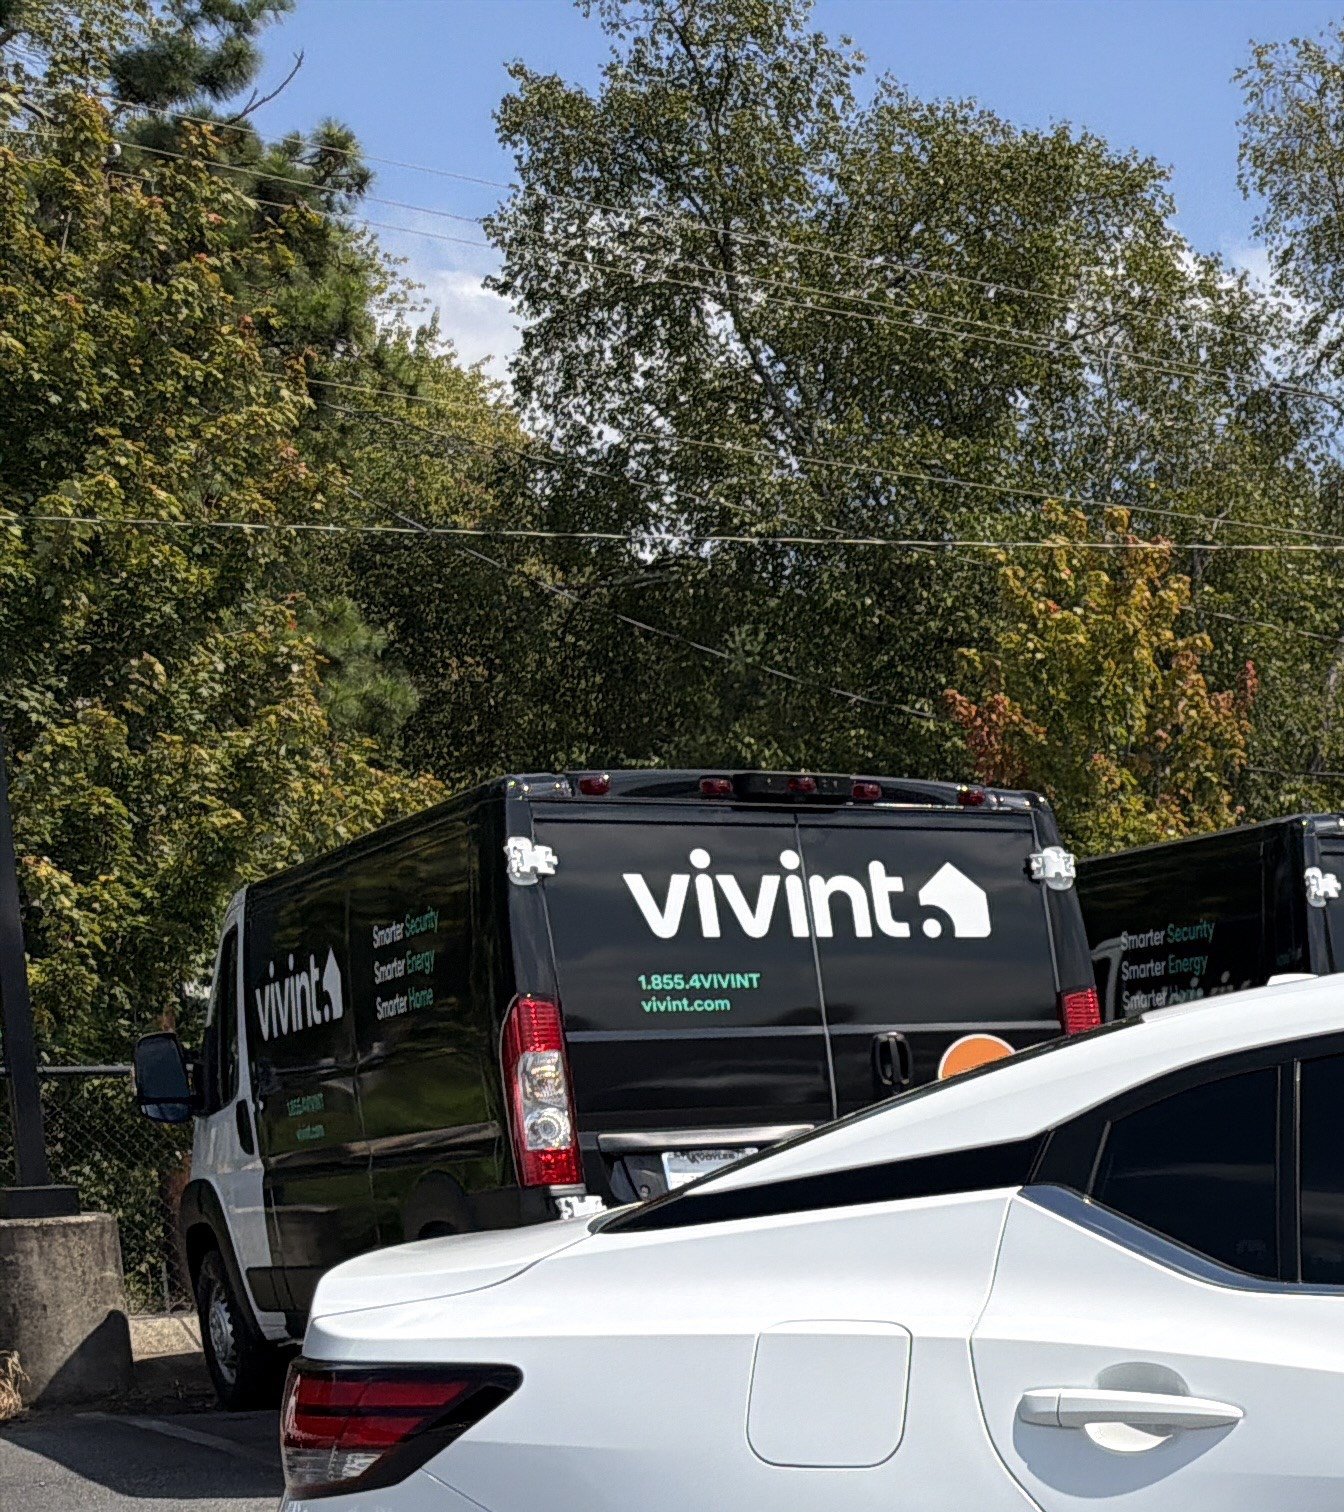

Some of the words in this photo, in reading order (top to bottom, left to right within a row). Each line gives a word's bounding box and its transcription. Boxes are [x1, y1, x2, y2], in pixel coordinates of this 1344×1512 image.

[373, 921, 404, 949] Smarter
[1120, 929, 1165, 951] Smarter
[1166, 919, 1215, 943] Security
[374, 957, 406, 984] Smarter
[1121, 959, 1166, 981] Smarter
[1167, 953, 1208, 975] Energy
[638, 972, 761, 991] 1.855.4VIVINT
[376, 993, 407, 1020] Smarter
[641, 996, 731, 1014] vivint.com
